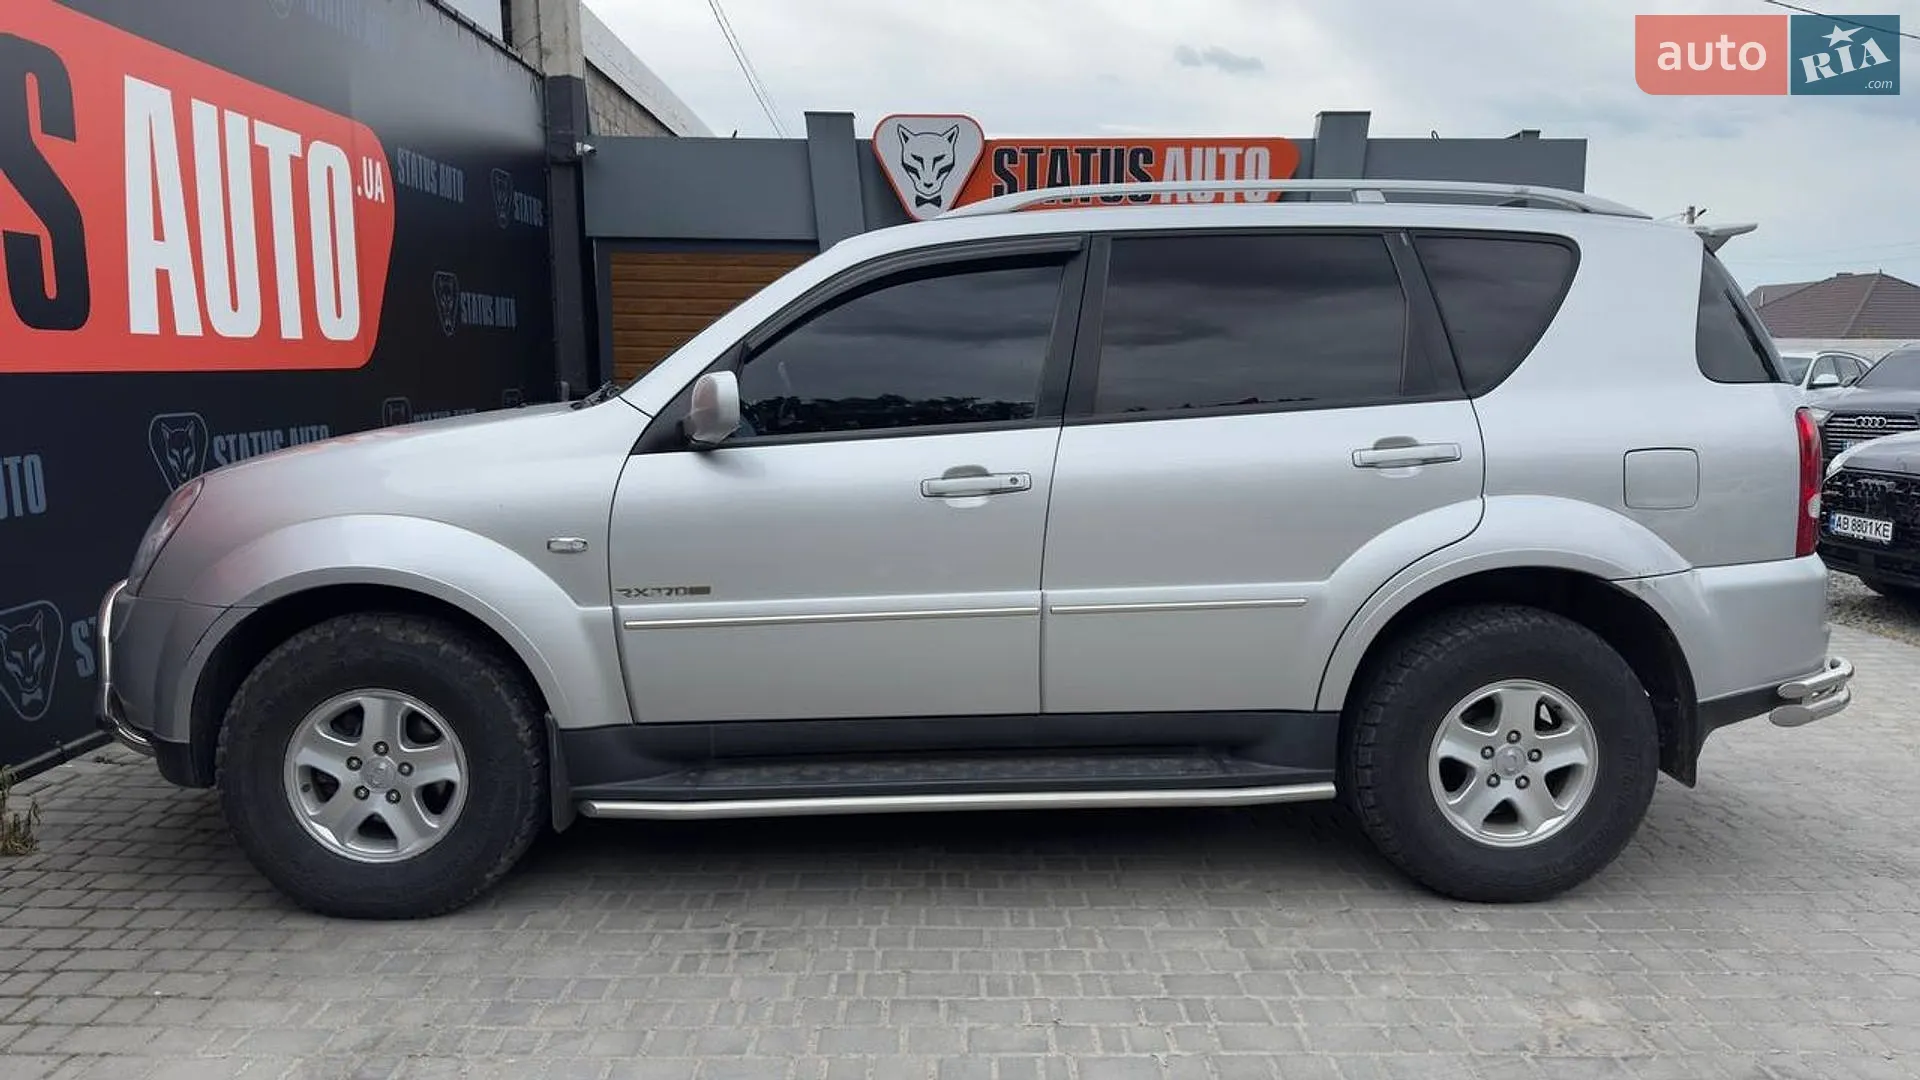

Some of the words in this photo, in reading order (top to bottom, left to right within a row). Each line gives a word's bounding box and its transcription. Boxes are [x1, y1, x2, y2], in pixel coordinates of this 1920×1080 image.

[397, 147, 438, 196] STATUS
[438, 162, 464, 203] AUTO
[992, 146, 1155, 205] STATUS
[1159, 146, 1271, 204] AUTO
[124, 74, 361, 341] AUTO
[357, 157, 386, 203] .UA
[71, 616, 97, 678] S
